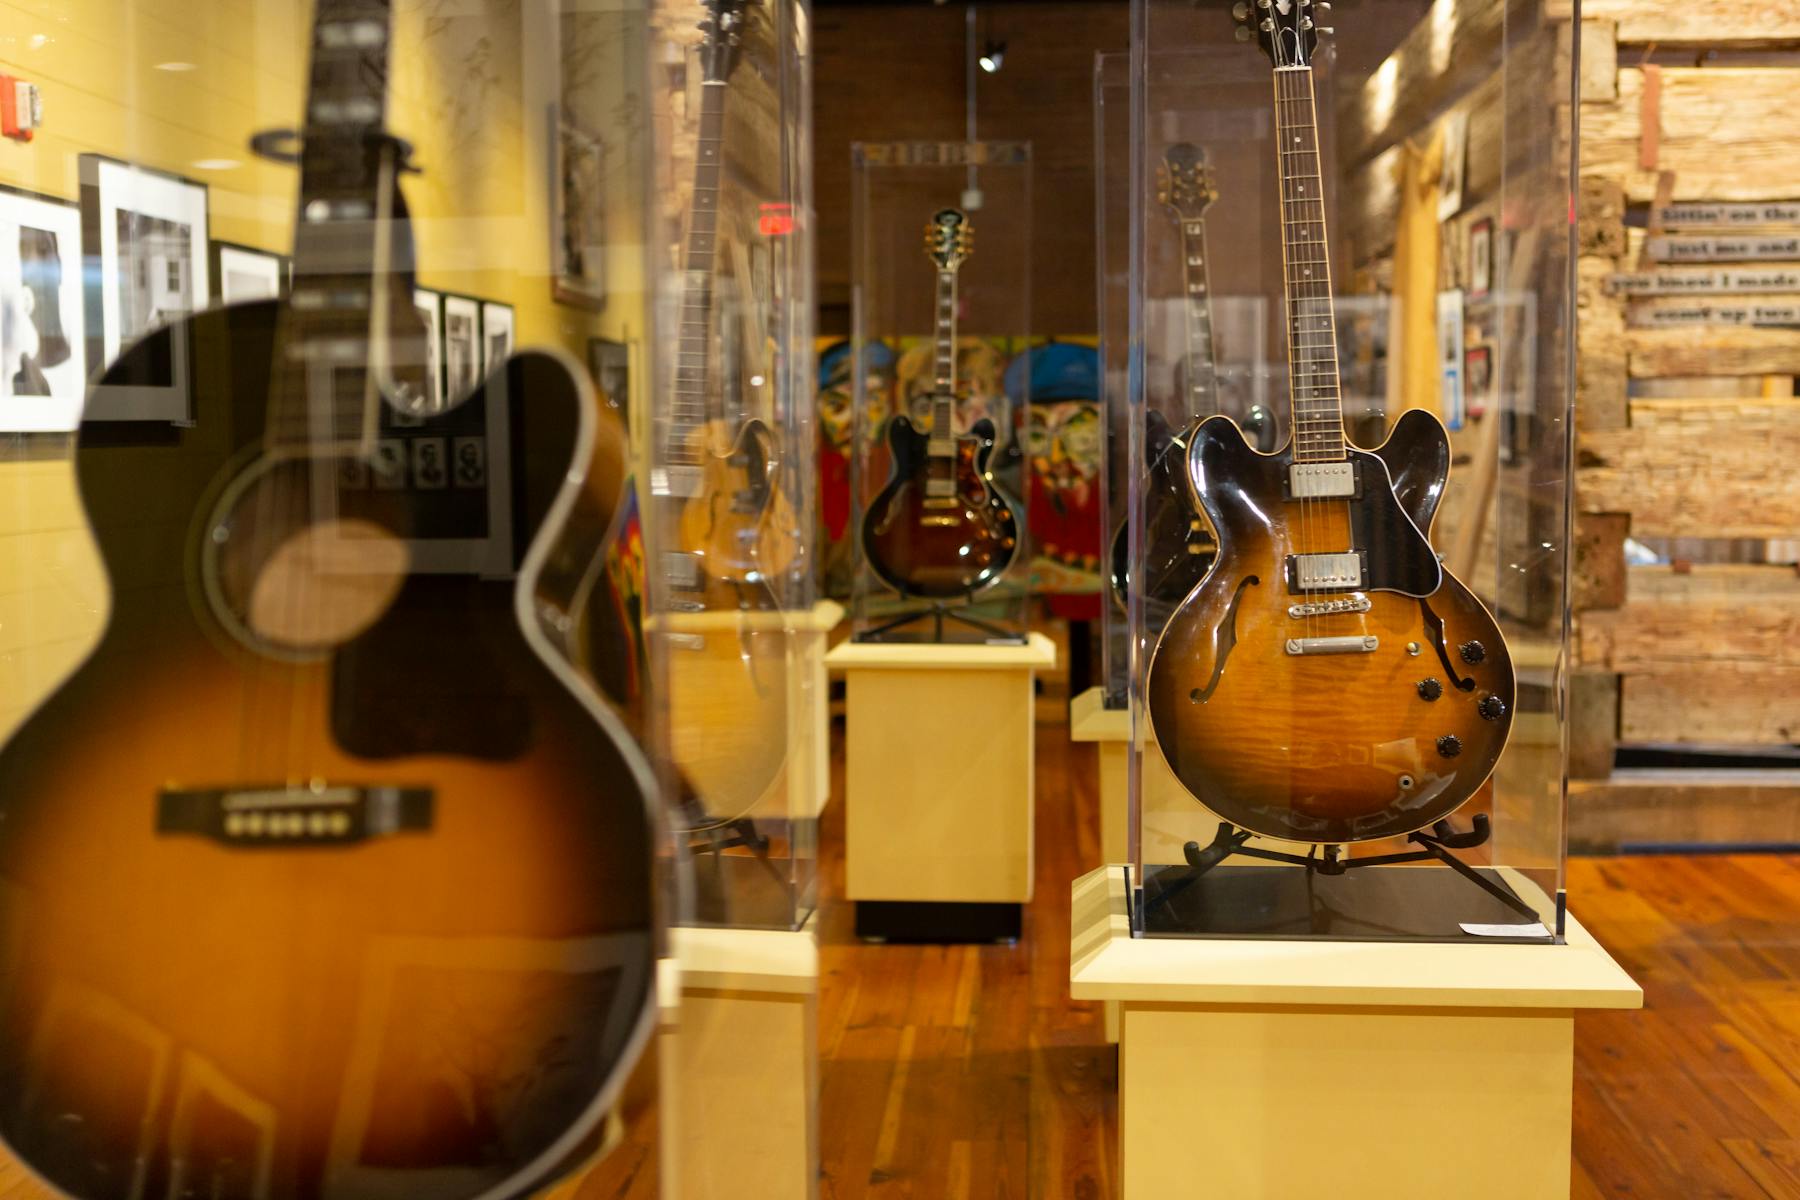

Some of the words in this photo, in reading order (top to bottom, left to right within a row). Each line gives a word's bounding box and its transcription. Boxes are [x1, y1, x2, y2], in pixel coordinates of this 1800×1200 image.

[1729, 210, 1757, 220] on
[1764, 207, 1798, 219] the
[1668, 241, 1709, 257] just
[1715, 243, 1747, 252] me
[1758, 240, 1798, 252] and
[1611, 278, 1650, 292] you
[1657, 276, 1713, 287] know
[1722, 275, 1729, 287] I
[1737, 274, 1798, 286] made
[1720, 309, 1747, 323] up
[1755, 307, 1794, 319] two
